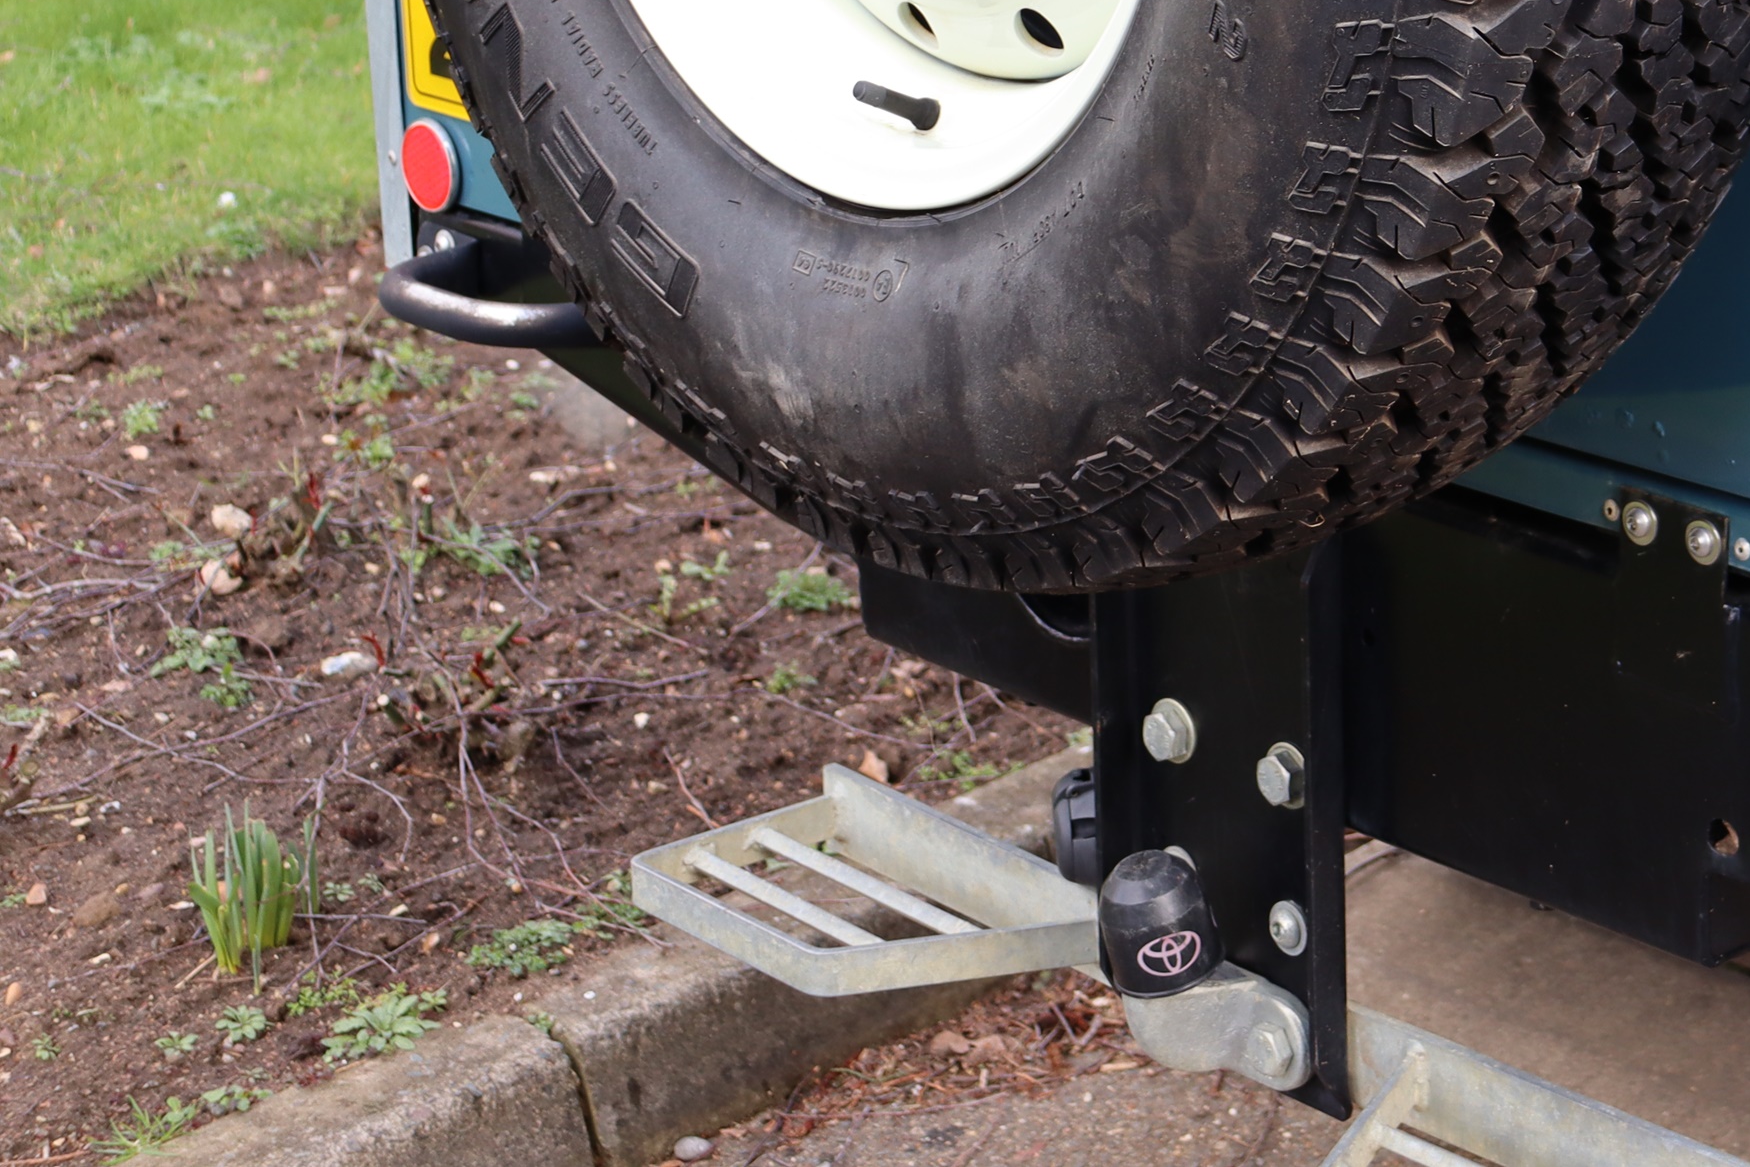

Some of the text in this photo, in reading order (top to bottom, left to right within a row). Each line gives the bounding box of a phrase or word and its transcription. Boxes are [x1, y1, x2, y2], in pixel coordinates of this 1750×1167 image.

[561, 10, 605, 80] RADIAL
[602, 81, 659, 157] TUBELESS
[1060, 180, 1087, 219] DOT
